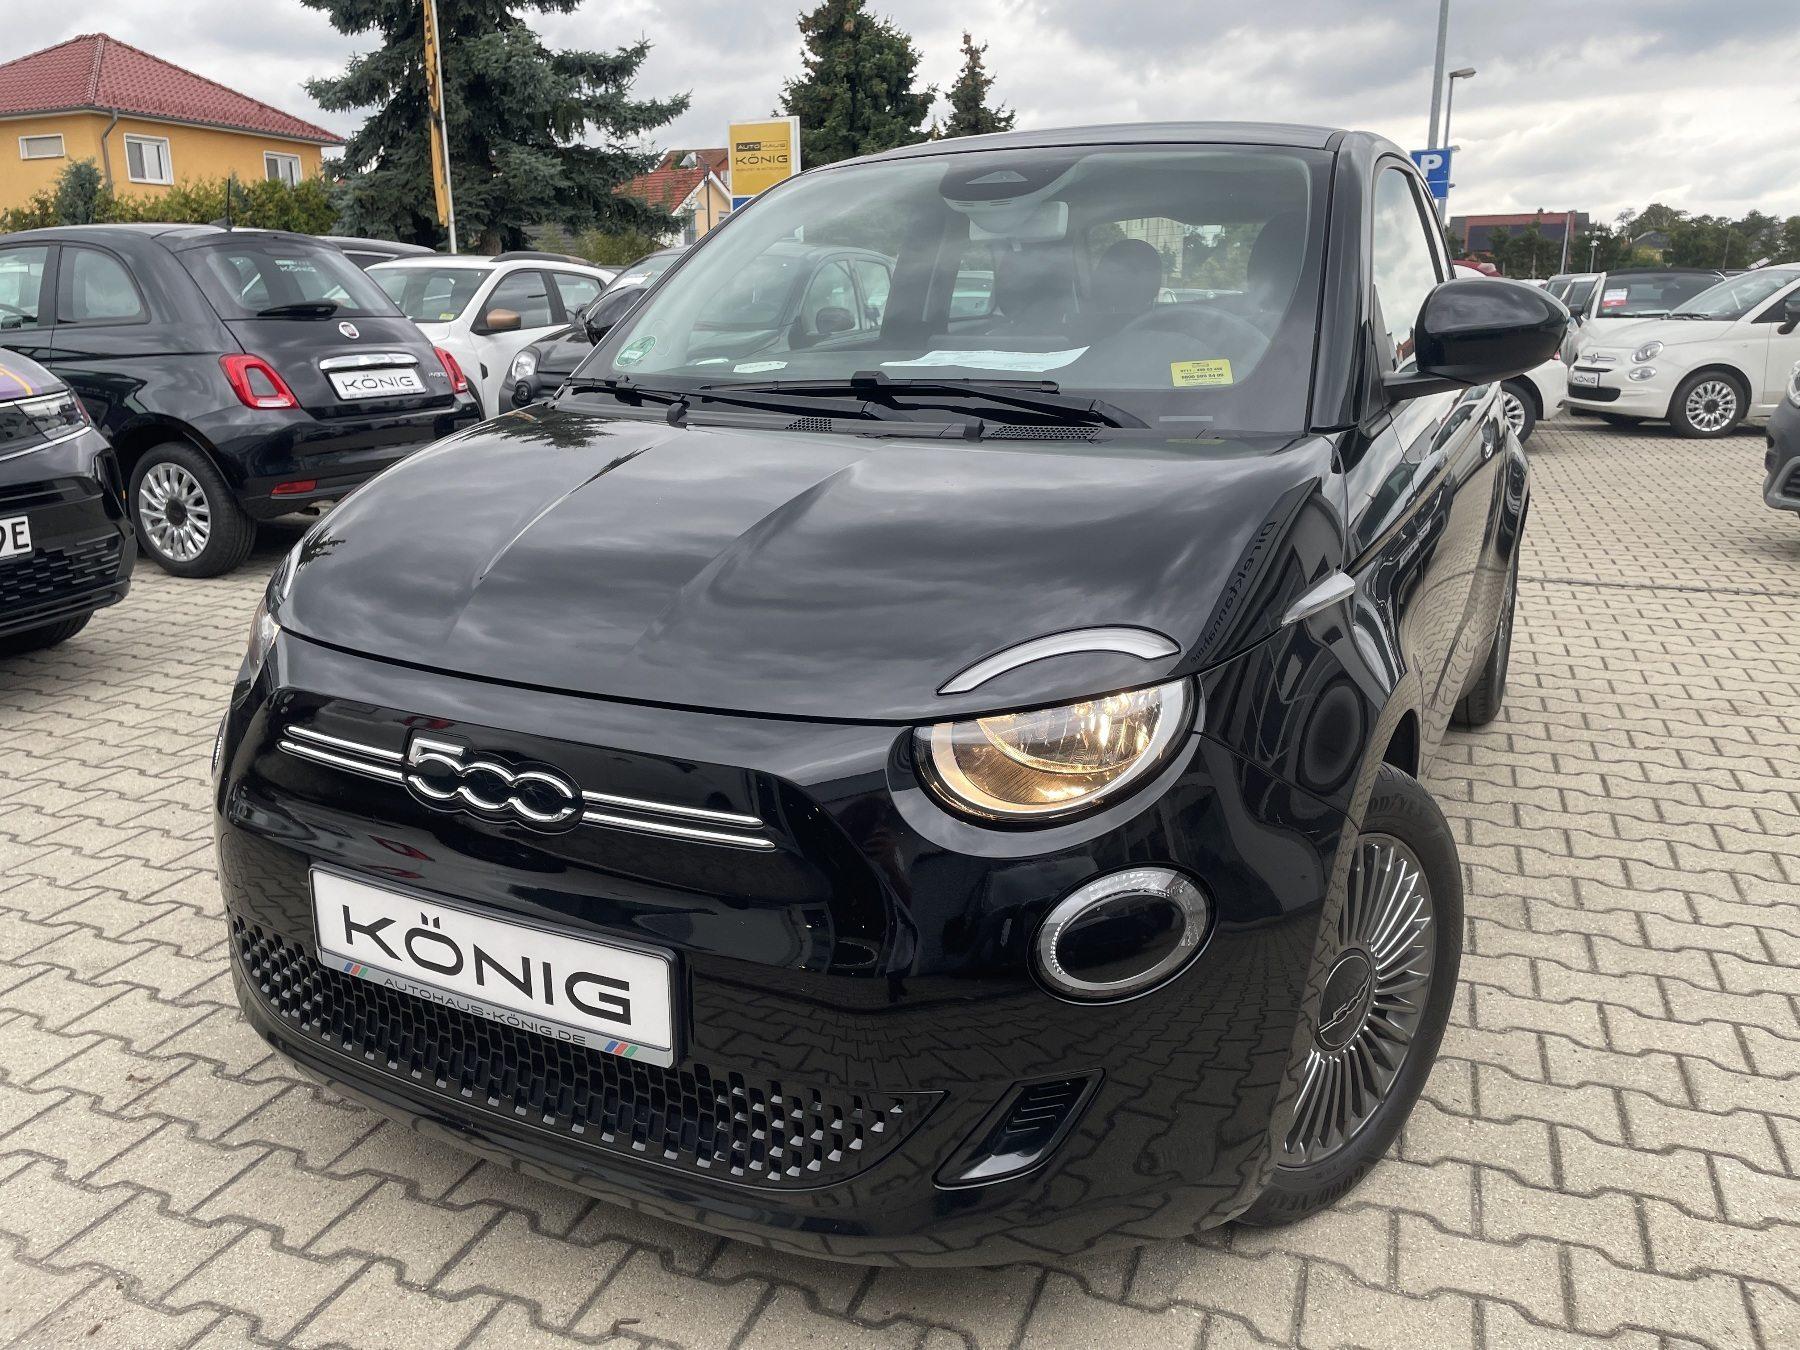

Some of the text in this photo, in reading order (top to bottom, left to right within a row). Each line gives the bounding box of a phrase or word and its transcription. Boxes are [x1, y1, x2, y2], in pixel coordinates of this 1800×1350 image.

[735, 153, 788, 165] KÖNIG
[1419, 154, 1443, 179] P
[341, 373, 414, 392] KÖNIG
[407, 736, 577, 823] 500
[342, 904, 632, 1026] KÖNIG
[383, 977, 586, 1044] AUTOHAUS-KÖNIG.DE
